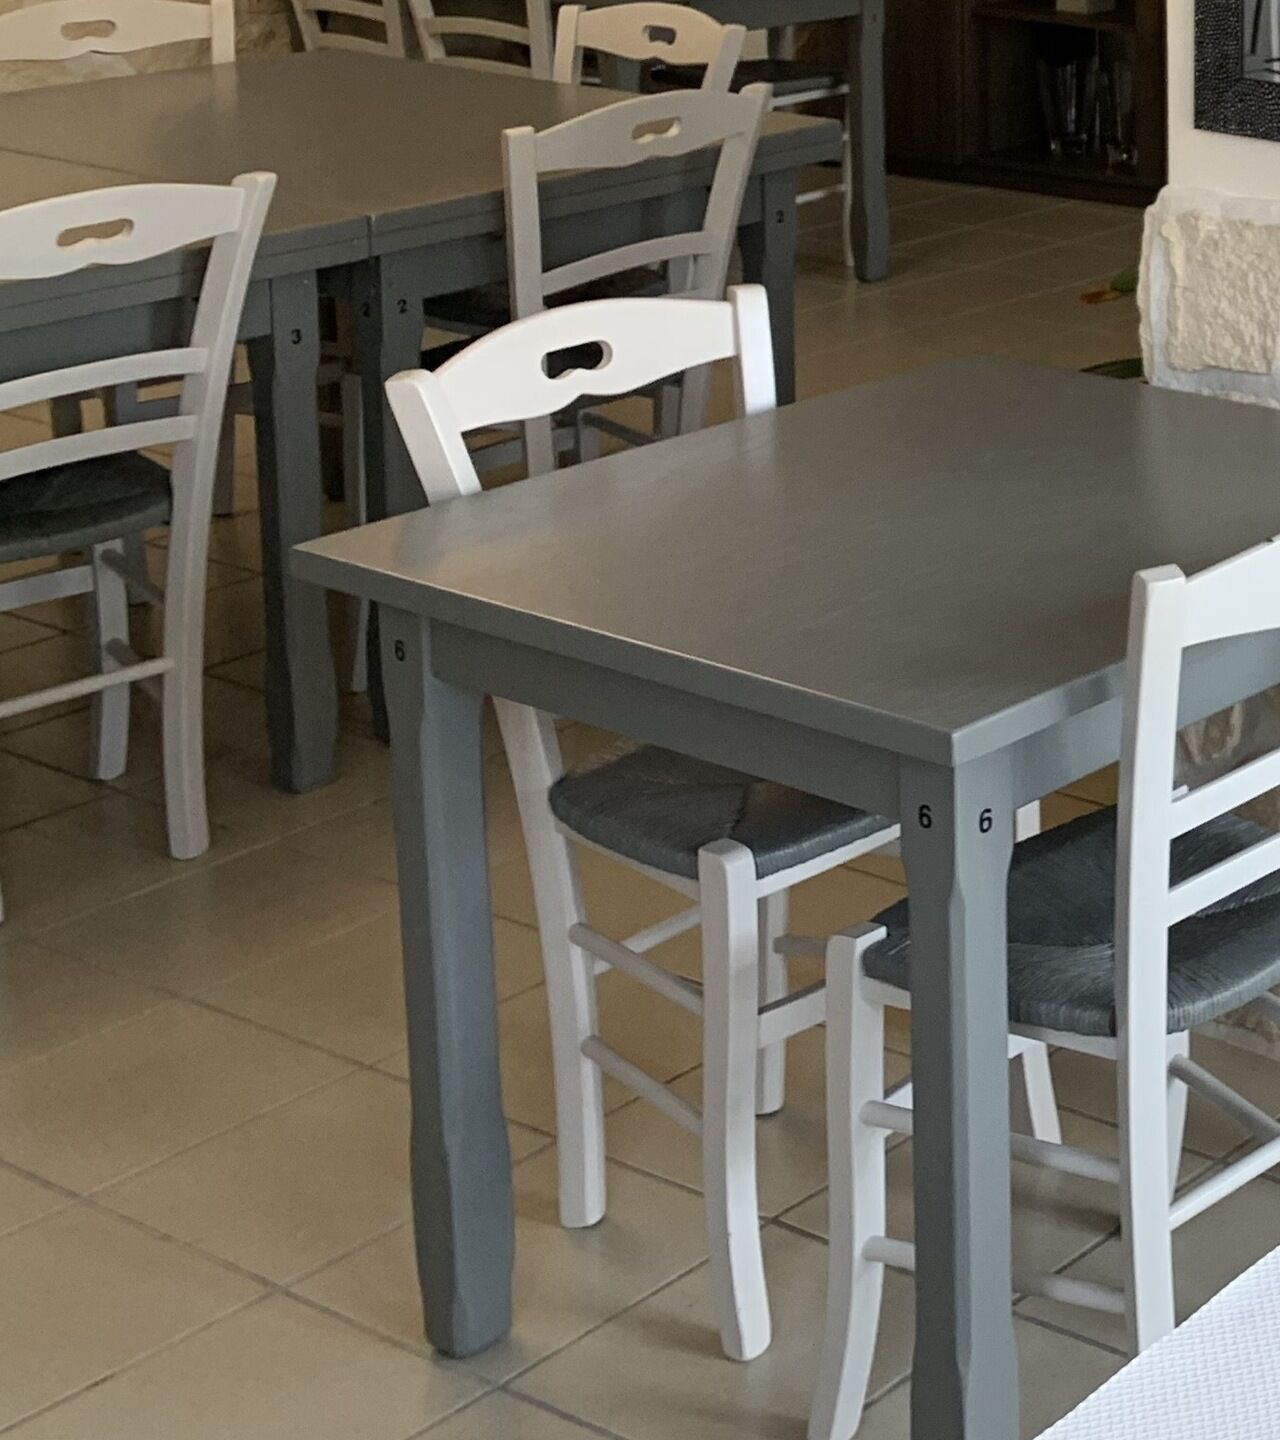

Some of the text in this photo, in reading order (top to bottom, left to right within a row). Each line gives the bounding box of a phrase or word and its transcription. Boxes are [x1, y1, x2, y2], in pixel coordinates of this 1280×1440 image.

[397, 299, 407, 314] 2
[291, 328, 302, 344] 3
[395, 640, 405, 662] 6
[918, 804, 932, 829] 6
[979, 808, 992, 833] 6
